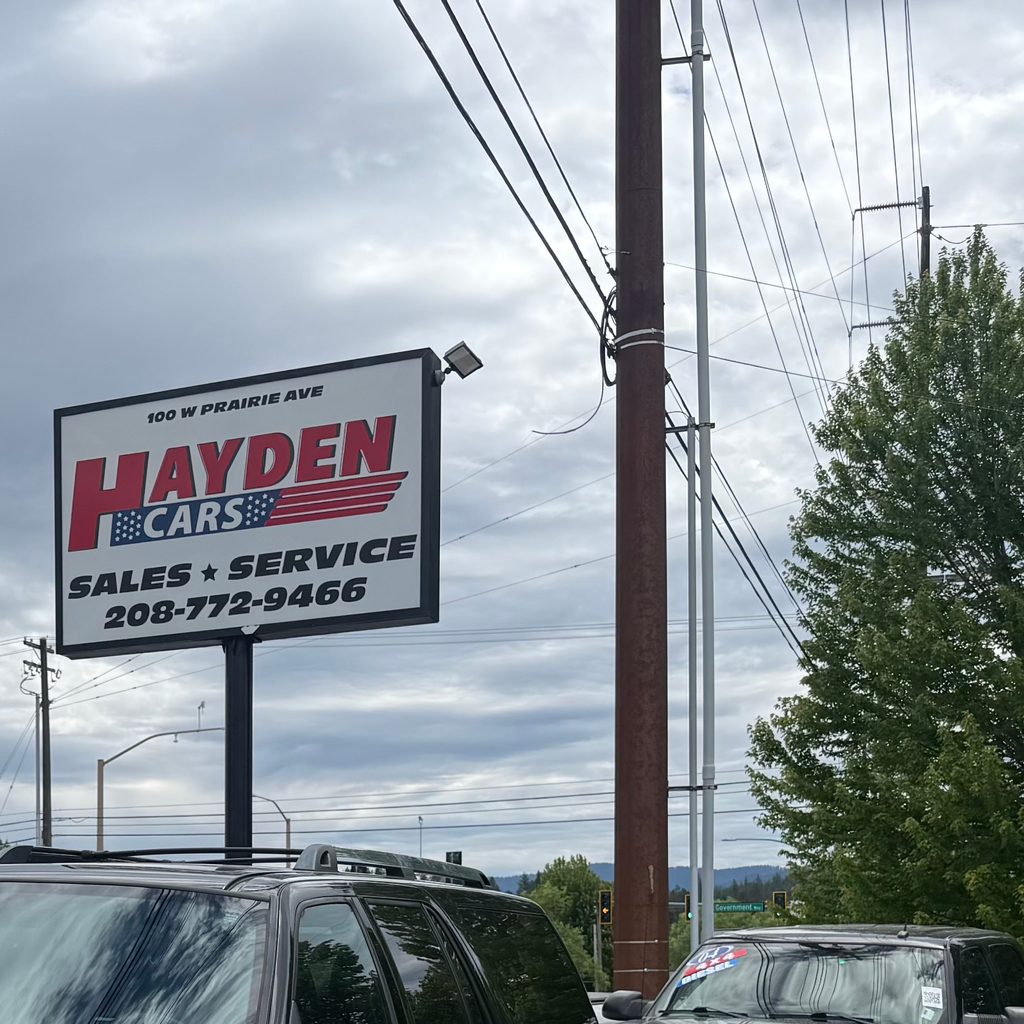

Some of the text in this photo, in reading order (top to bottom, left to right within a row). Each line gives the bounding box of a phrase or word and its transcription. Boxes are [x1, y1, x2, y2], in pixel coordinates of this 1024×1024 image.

[147, 385, 324, 424] 100 W PRAIRIE AVE
[68, 415, 397, 552] HAYDEN
[143, 497, 245, 539] CARS
[68, 534, 418, 600] SALES SERVICE
[104, 577, 368, 630] 208-772-9466
[681, 961, 734, 985] DIESEL
